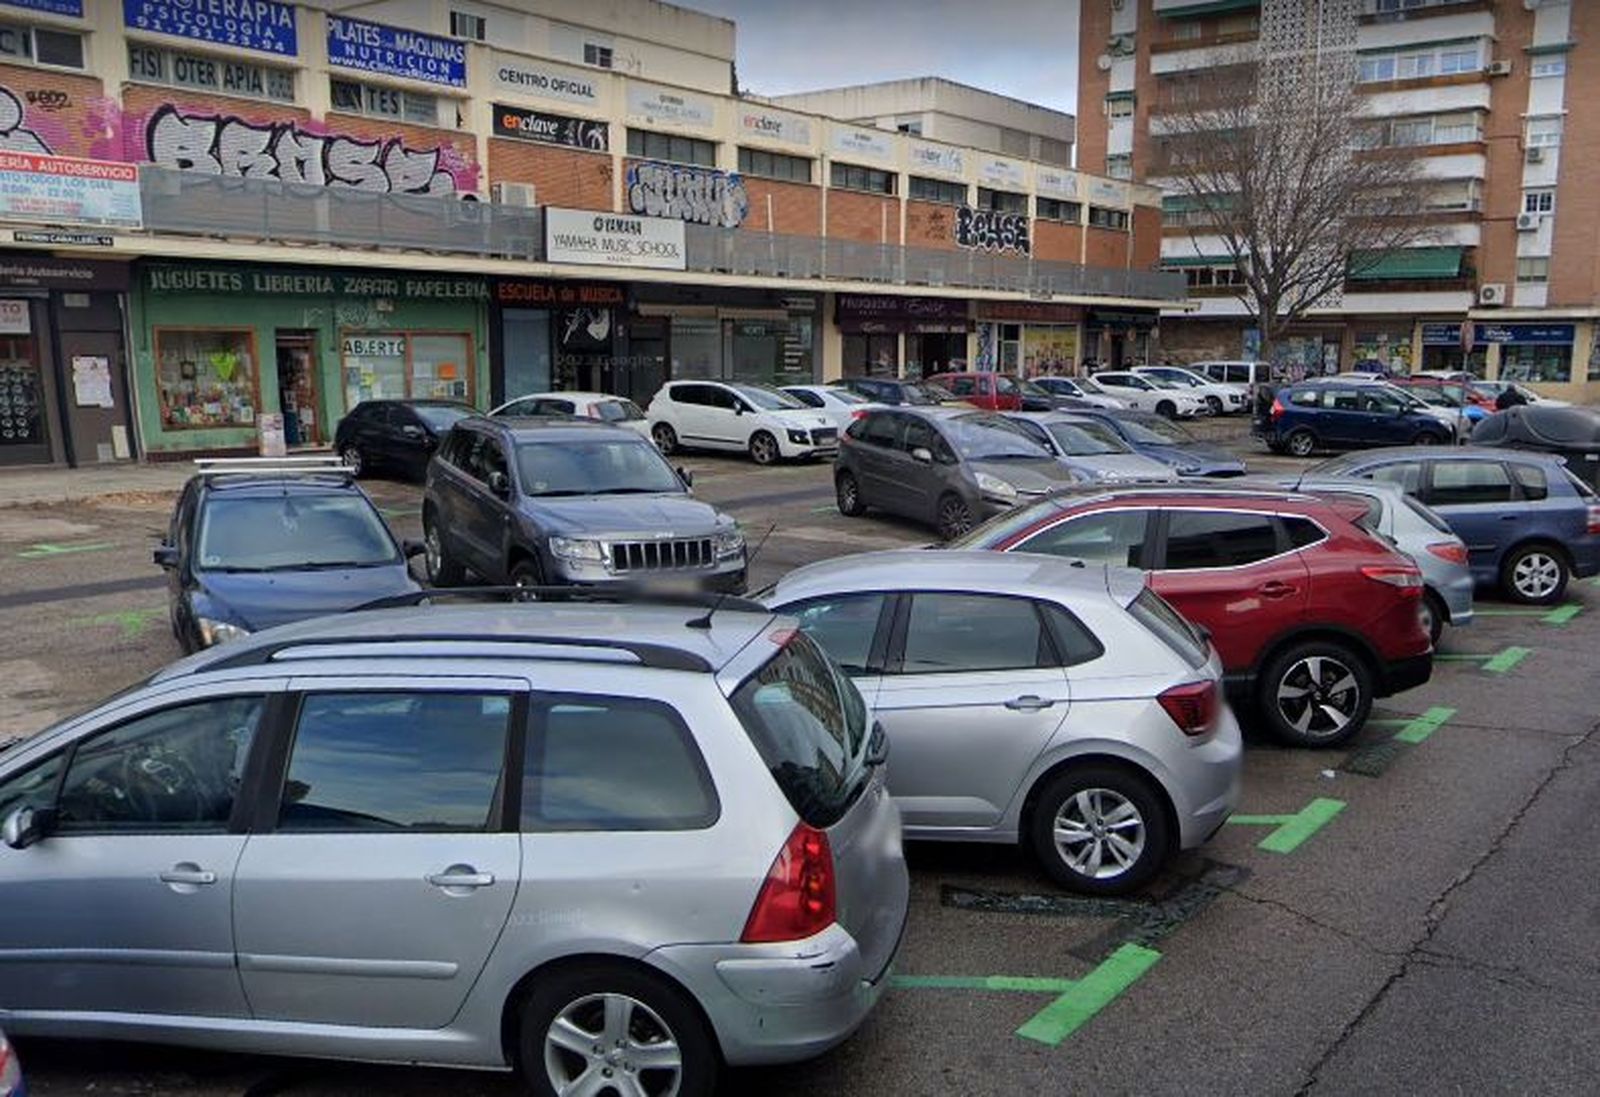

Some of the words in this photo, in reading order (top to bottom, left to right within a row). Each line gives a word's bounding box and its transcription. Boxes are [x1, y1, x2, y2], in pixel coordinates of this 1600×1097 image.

[152, 0, 292, 28] OTERAPIA
[327, 17, 382, 47] PILATES
[499, 67, 549, 89] CENTRO
[551, 78, 596, 98] OFICIAL
[502, 114, 559, 135] enclave
[38, 159, 133, 180] AUTOSERVICIO
[605, 218, 642, 236] YAMAHA
[553, 234, 599, 250] YAMAHA
[601, 238, 636, 255] MUSIC
[637, 241, 681, 258] SCHOOL
[498, 283, 556, 302] ESCUELA
[343, 339, 406, 354] ABIERTO
